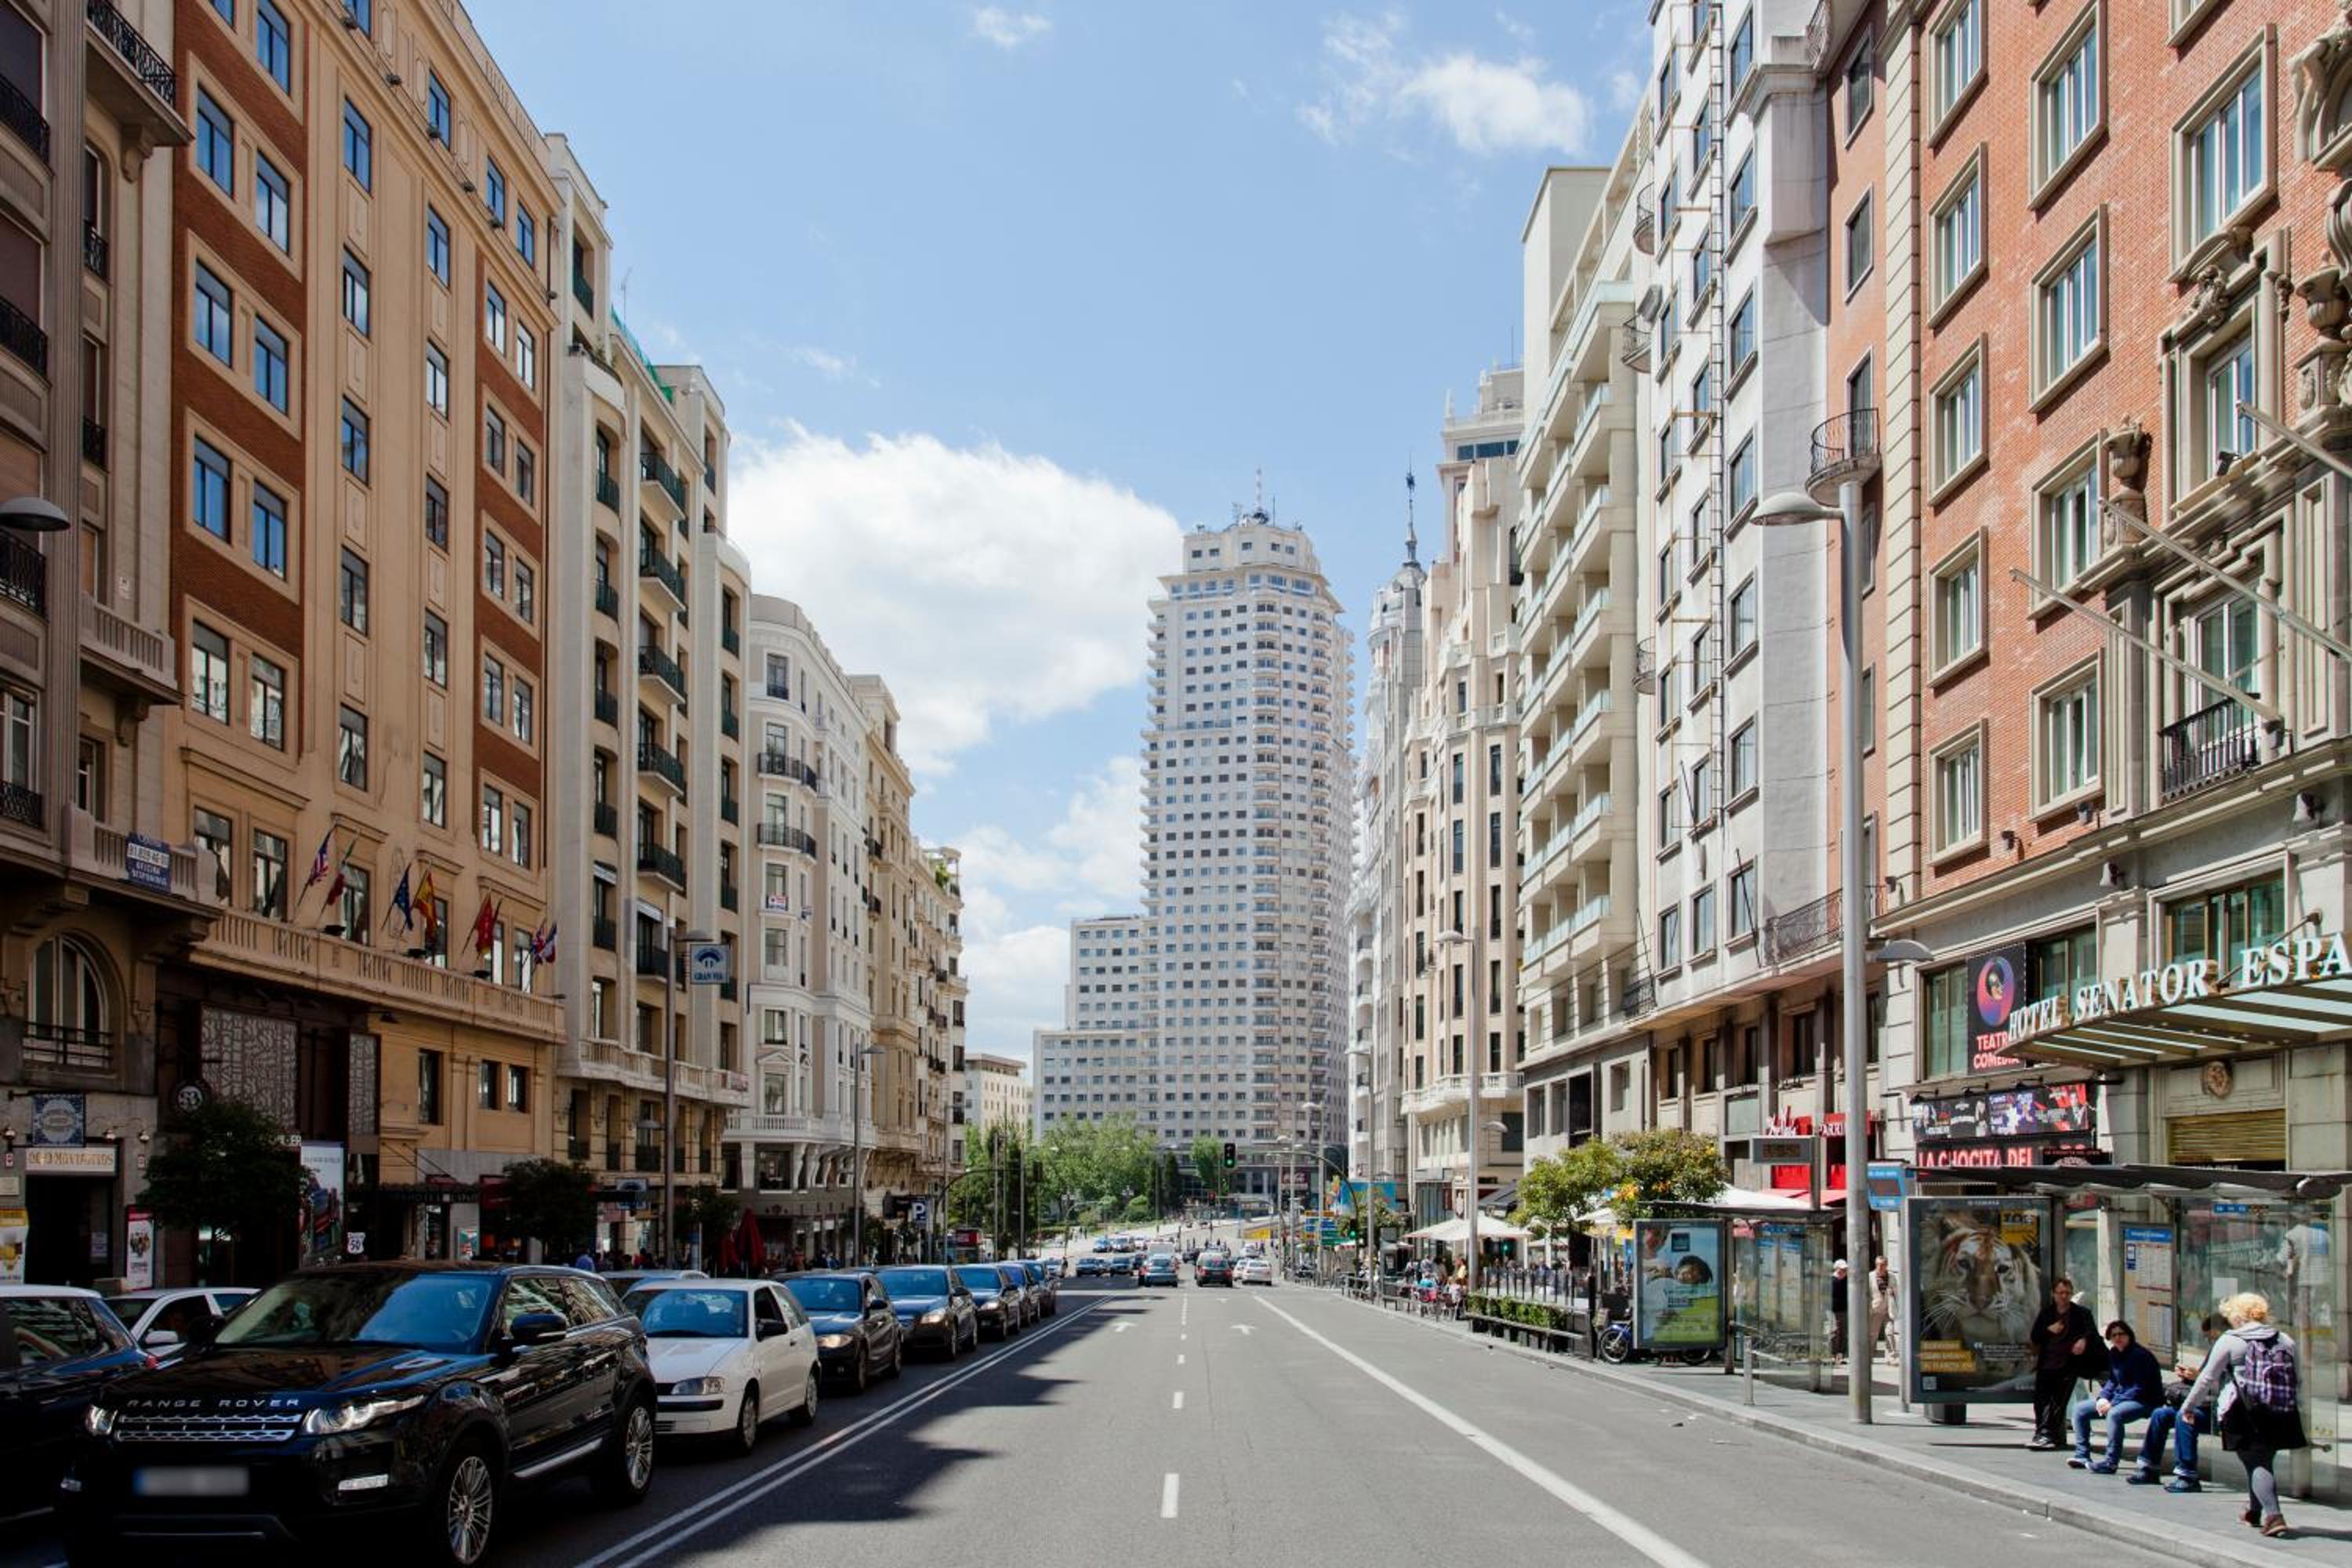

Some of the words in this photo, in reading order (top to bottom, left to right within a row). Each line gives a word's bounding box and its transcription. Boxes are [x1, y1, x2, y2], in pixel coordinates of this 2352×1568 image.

[2009, 995, 2061, 1041] HOTEL
[2074, 959, 2209, 1022] SENATOR
[2238, 933, 2352, 989] ESPA
[1976, 1031, 2008, 1051] TEATR
[1973, 1052, 2020, 1068] COME
[126, 1399, 201, 1408] RANGE
[218, 1399, 299, 1408] ROVER
